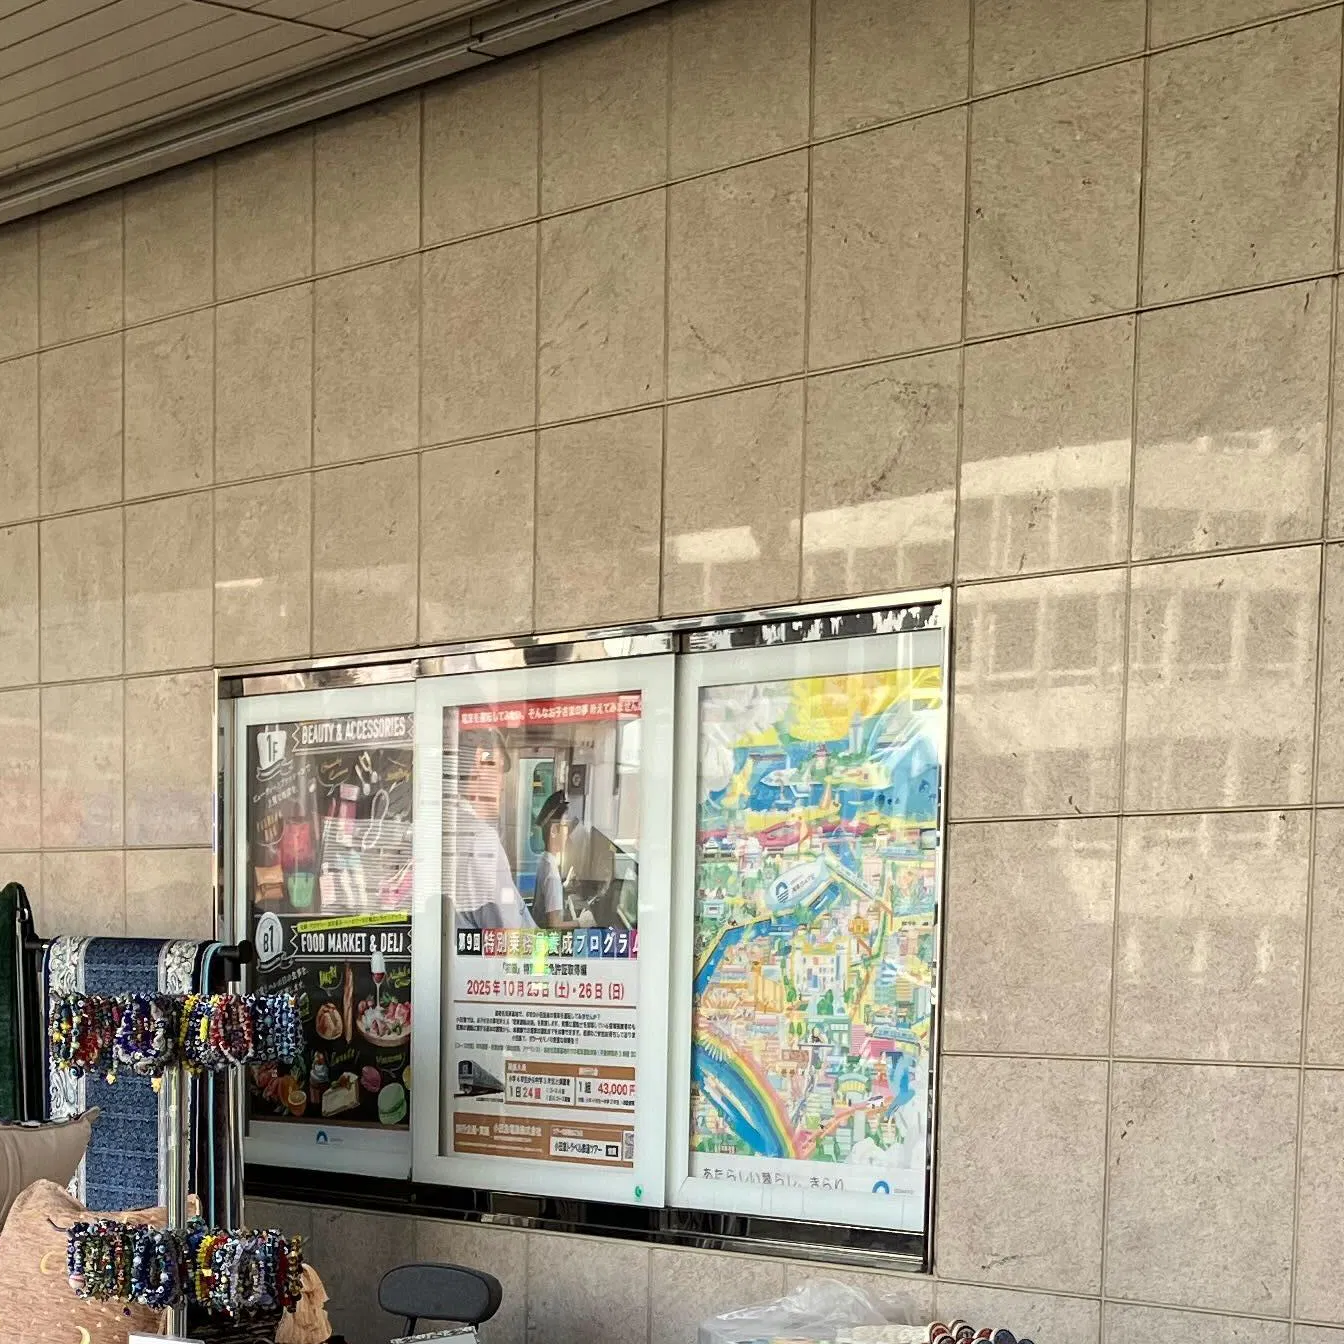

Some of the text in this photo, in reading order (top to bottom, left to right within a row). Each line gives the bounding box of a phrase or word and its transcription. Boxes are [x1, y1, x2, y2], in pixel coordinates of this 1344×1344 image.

[301, 722, 335, 745] BEAUTY
[344, 716, 407, 741] ACCESSORIES
[301, 932, 404, 953] FOOD MARKET & DELI
